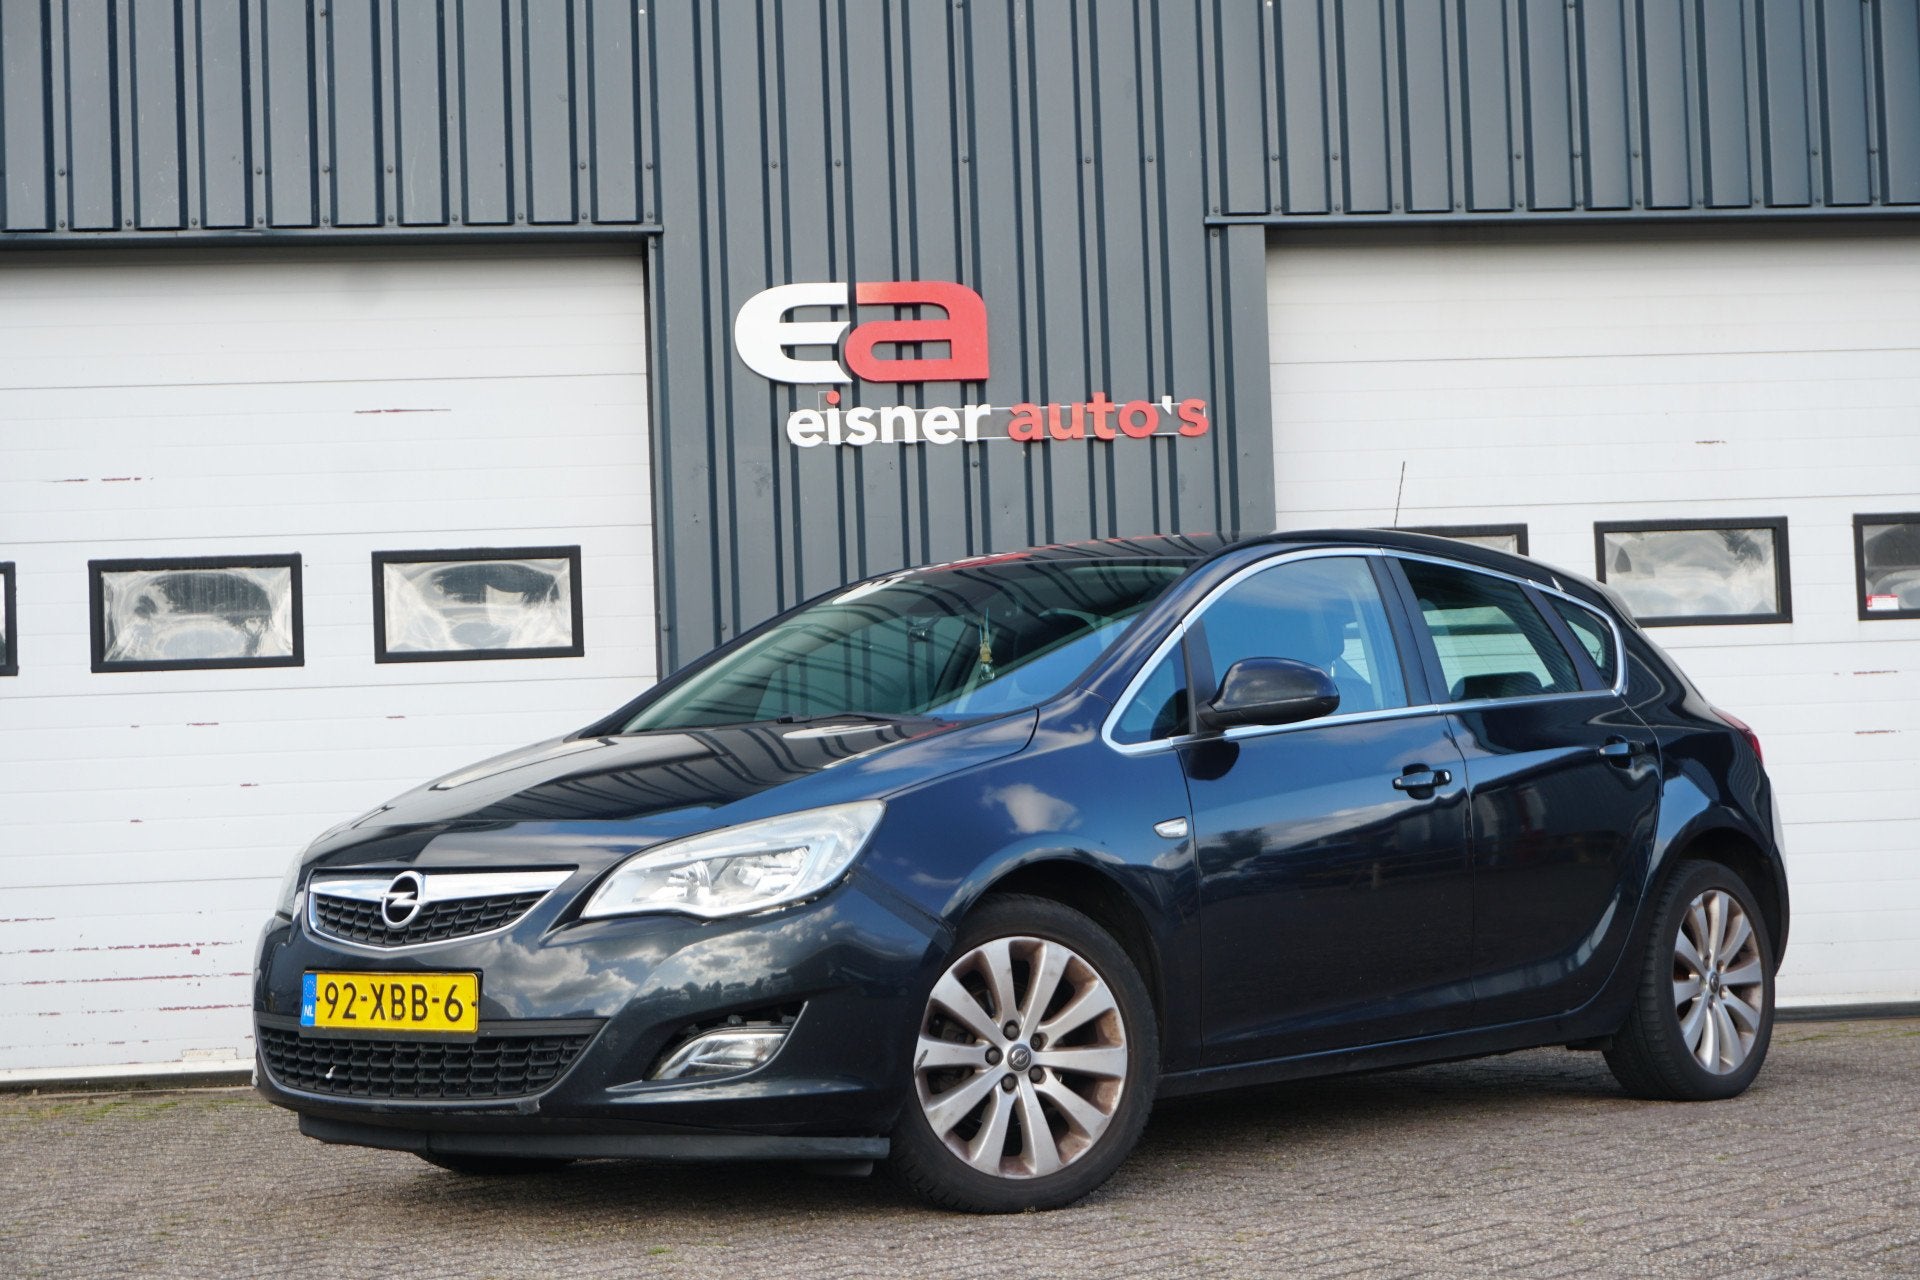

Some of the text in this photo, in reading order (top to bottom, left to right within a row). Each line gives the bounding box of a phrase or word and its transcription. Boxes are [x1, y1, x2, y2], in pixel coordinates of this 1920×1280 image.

[787, 390, 1209, 448] eisner auto's
[304, 981, 464, 1022] NL 92-XBB-6
